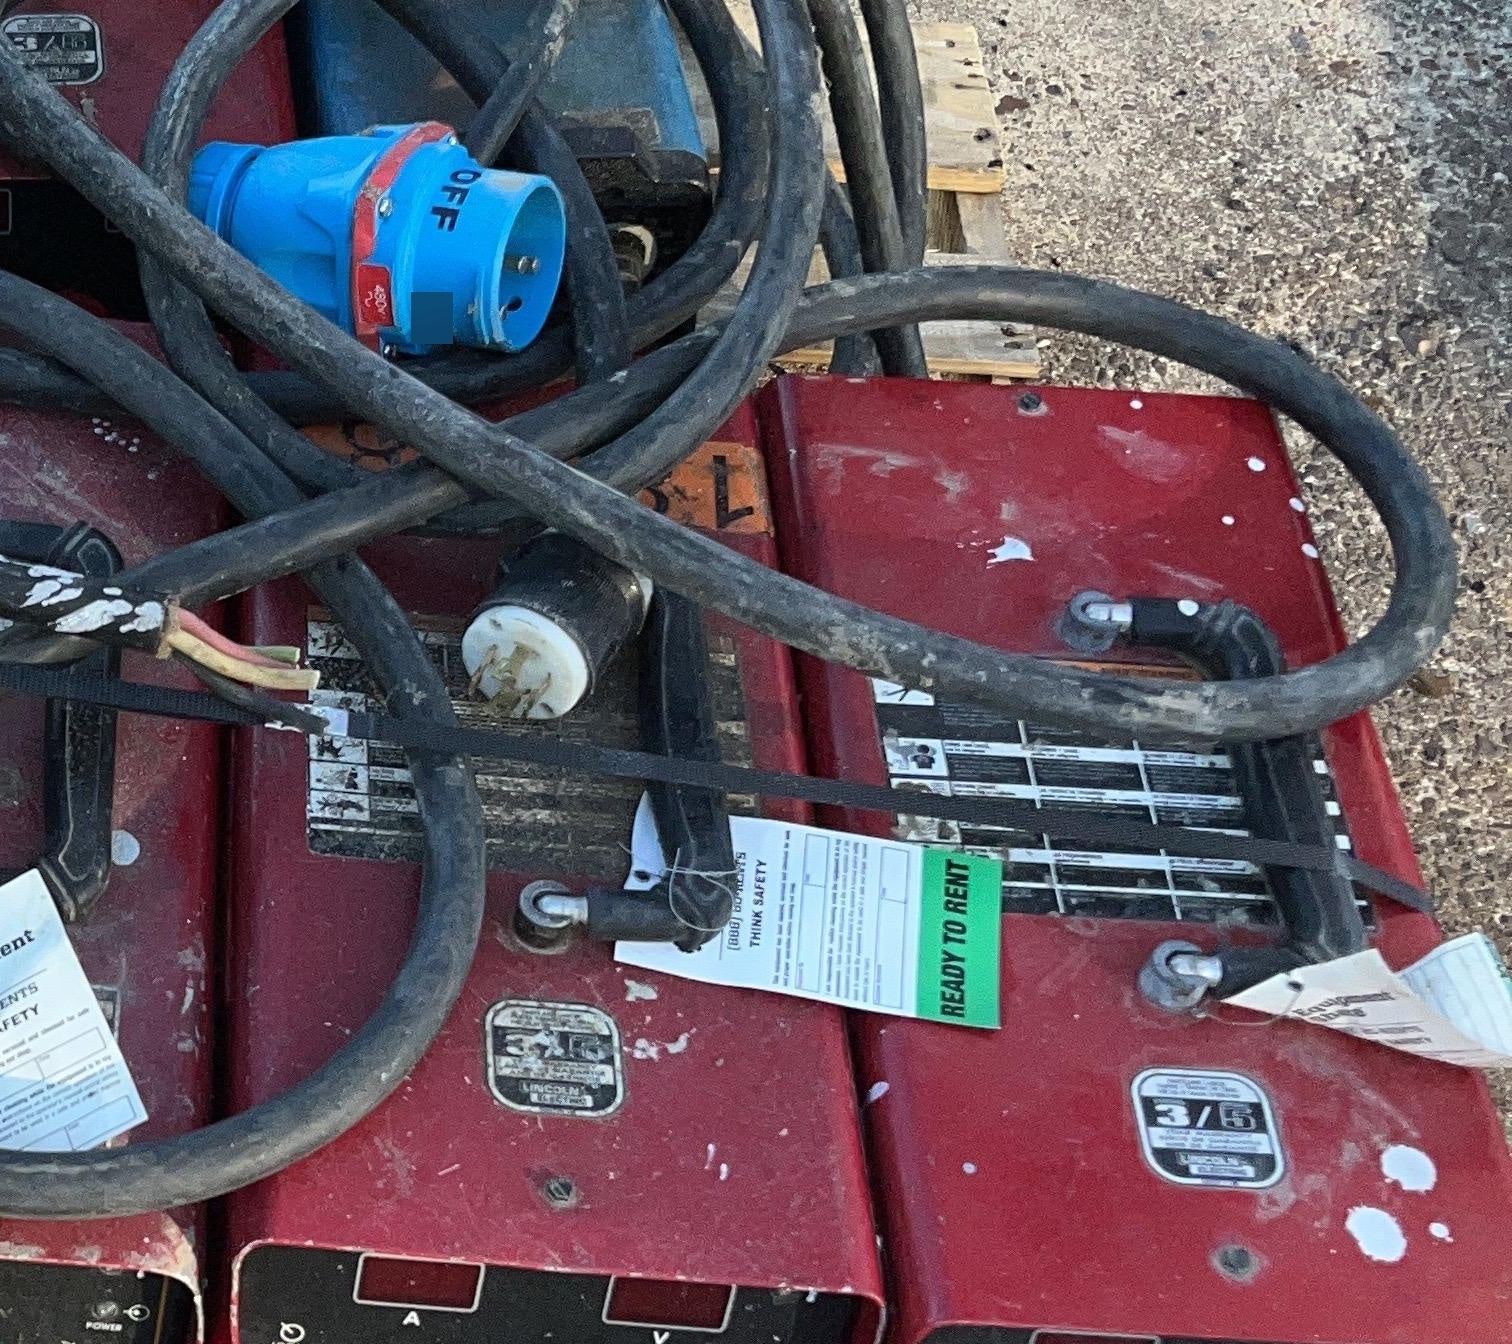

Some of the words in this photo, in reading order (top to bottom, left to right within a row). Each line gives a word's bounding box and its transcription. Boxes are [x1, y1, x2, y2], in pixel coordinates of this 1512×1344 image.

[431, 169, 482, 233] OFF
[752, 858, 767, 907] SAFETY
[944, 858, 970, 915] RENT
[749, 909, 765, 948] THINK
[943, 920, 968, 946] TO
[939, 949, 967, 1019] READY
[519, 1082, 582, 1096] LINCOLN
[85, 1321, 123, 1333] POWER
[402, 1310, 421, 1327] A
